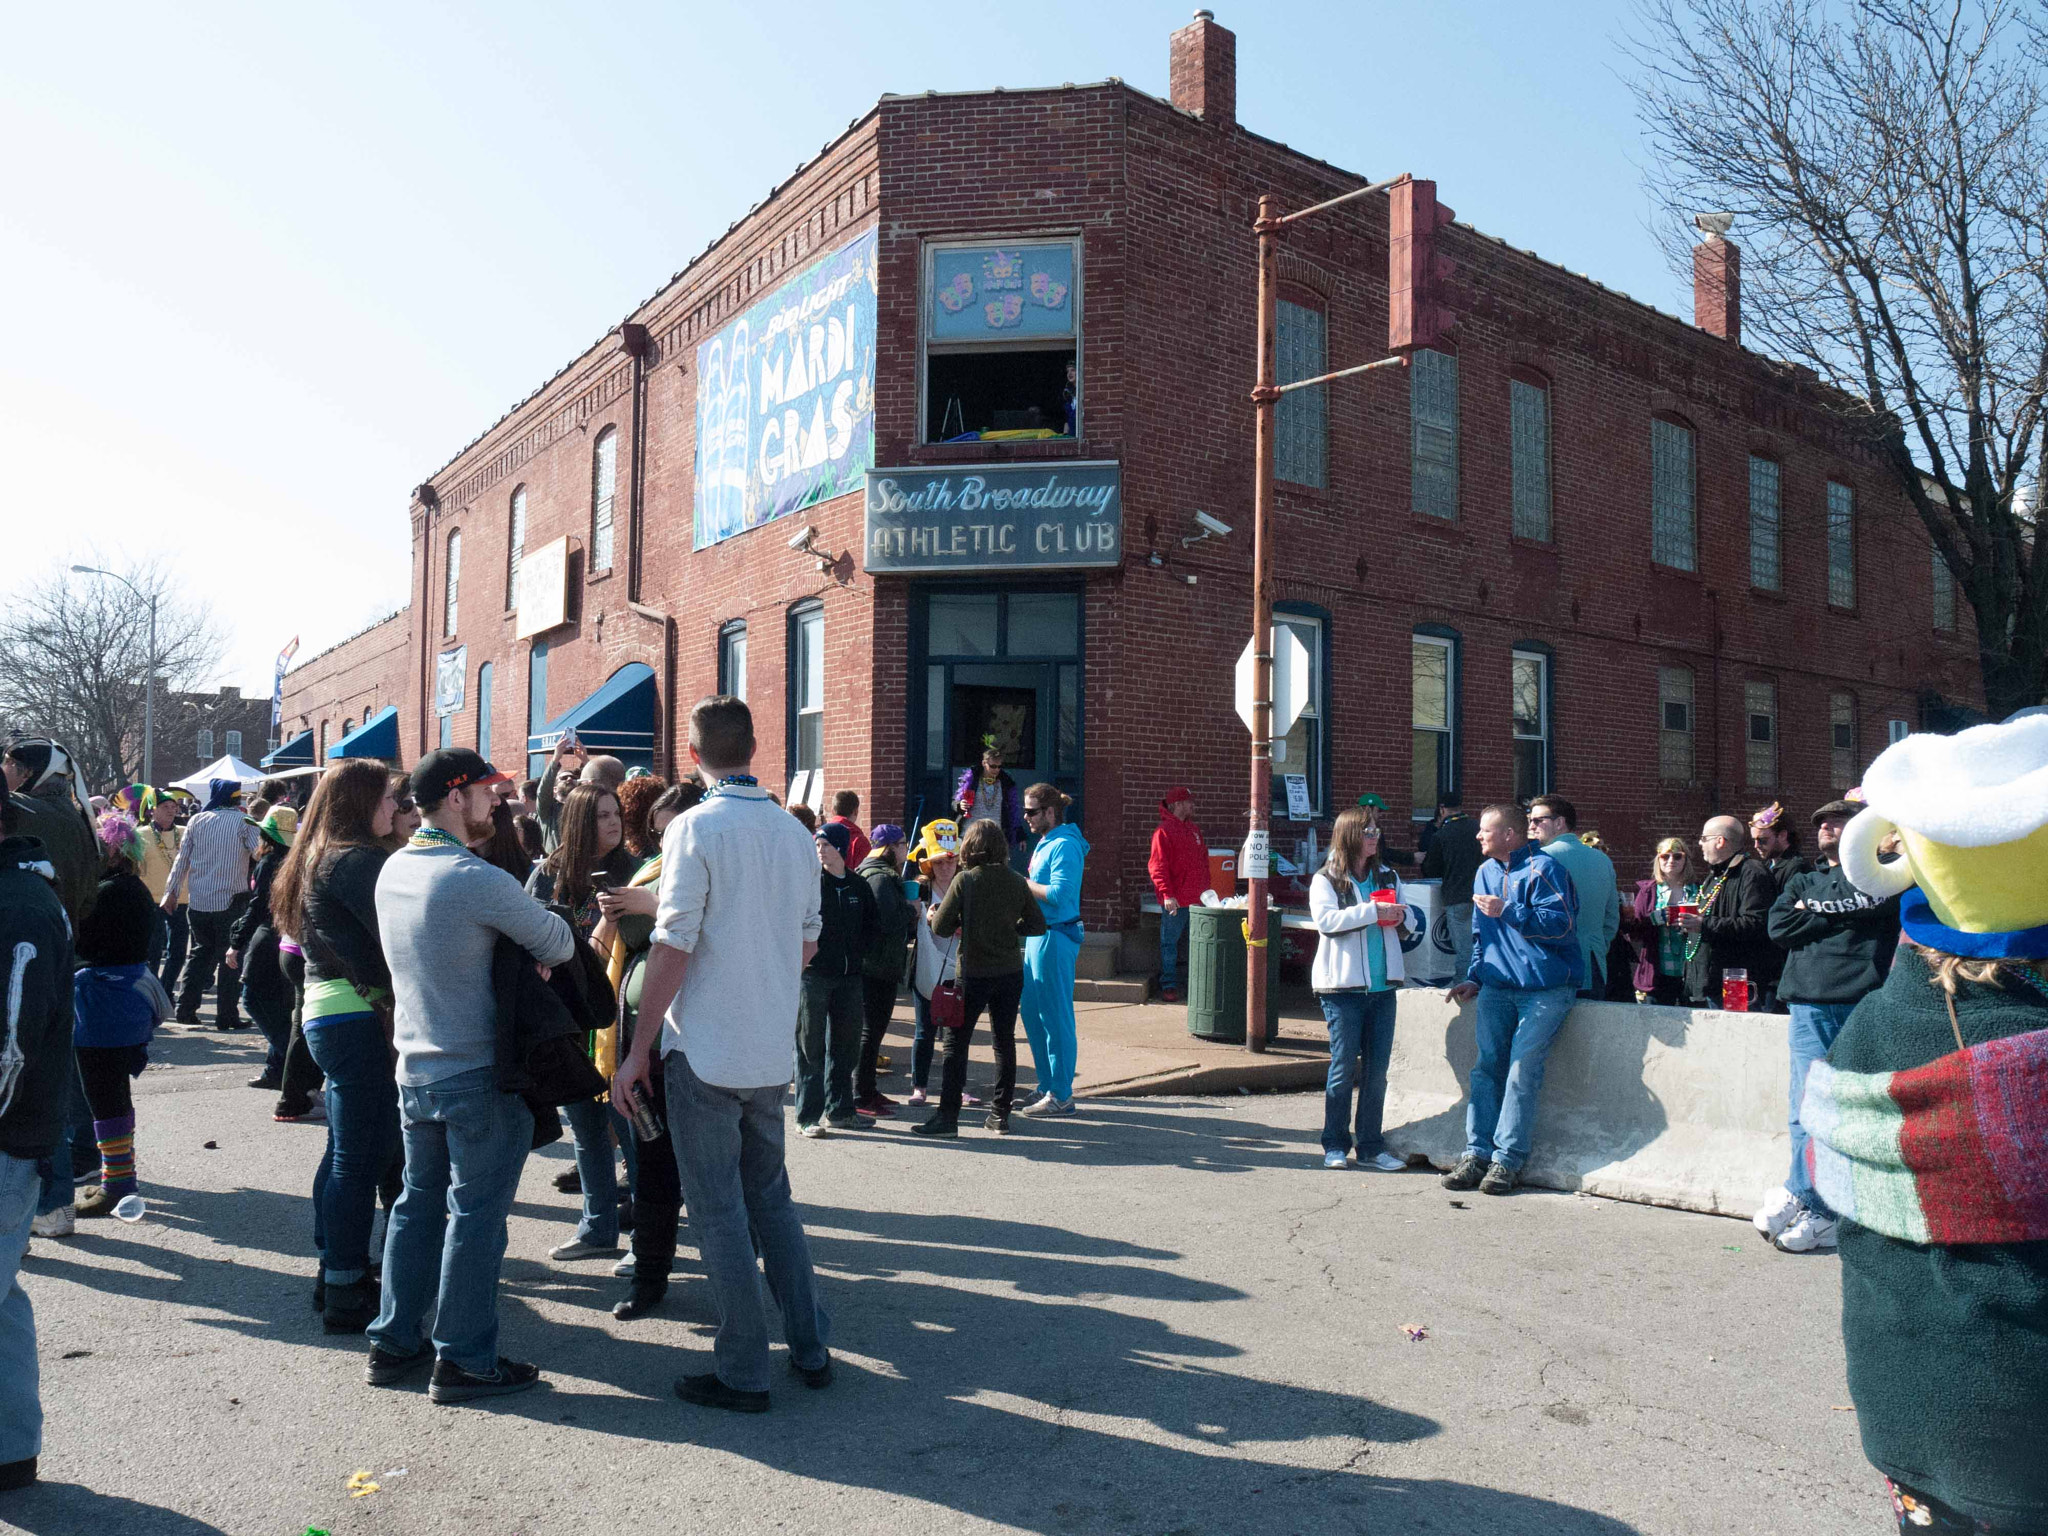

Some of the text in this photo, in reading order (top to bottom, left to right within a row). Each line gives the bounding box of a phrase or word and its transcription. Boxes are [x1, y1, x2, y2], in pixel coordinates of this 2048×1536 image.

[766, 272, 852, 341] BUD LIGHT
[760, 303, 855, 415] MARDI
[760, 379, 853, 486] GRAS
[869, 475, 1116, 516] South Broadway
[871, 522, 1115, 558] ATHLETIC CLUB
[1249, 842, 1263, 851] NO
[1249, 853, 1270, 861] POLIC
